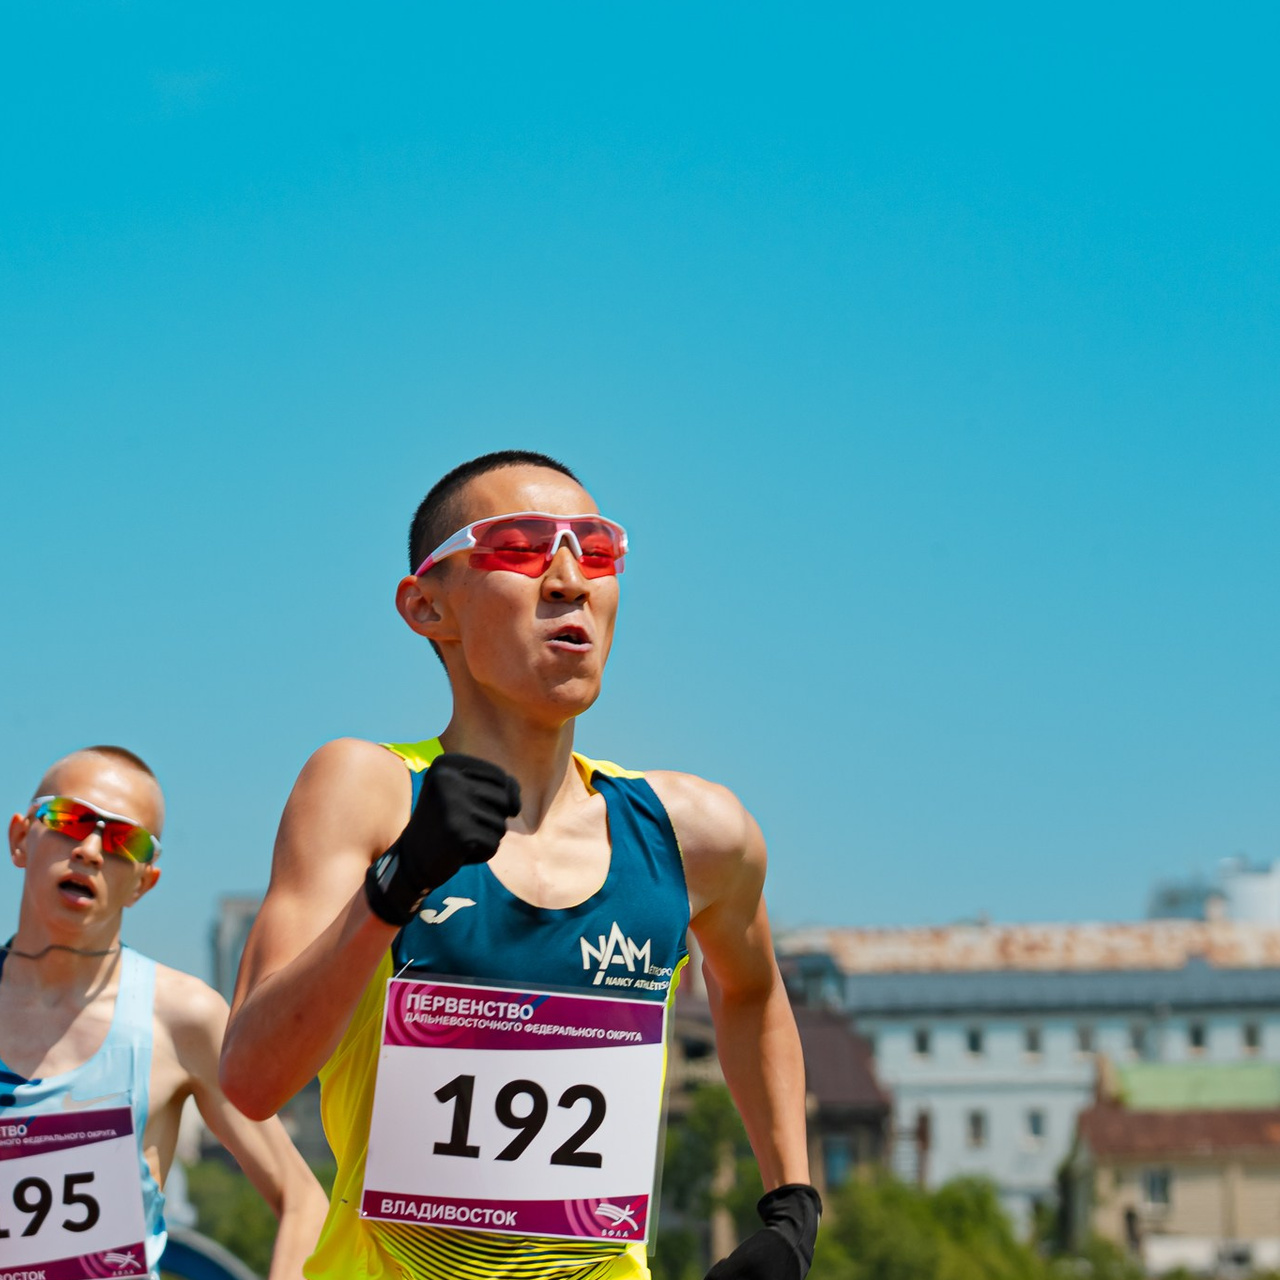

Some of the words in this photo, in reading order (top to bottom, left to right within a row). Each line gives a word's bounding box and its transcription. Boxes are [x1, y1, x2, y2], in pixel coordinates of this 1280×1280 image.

[605, 976, 634, 987] NANCY
[406, 993, 534, 1020] ПЕРВЕНСТВО
[403, 1011, 523, 1033] ДАЛЬНЕВОСТОЧНОГО
[524, 1023, 605, 1039] ФЕДЕРАЛЬНОГО
[606, 1029, 643, 1042] ОКРУГА
[433, 1074, 607, 1168] 192
[23, 1131, 85, 1144] ФЕДЕРАЛЬНОГО
[380, 1198, 519, 1227] ВЛАДИВОСТОК
